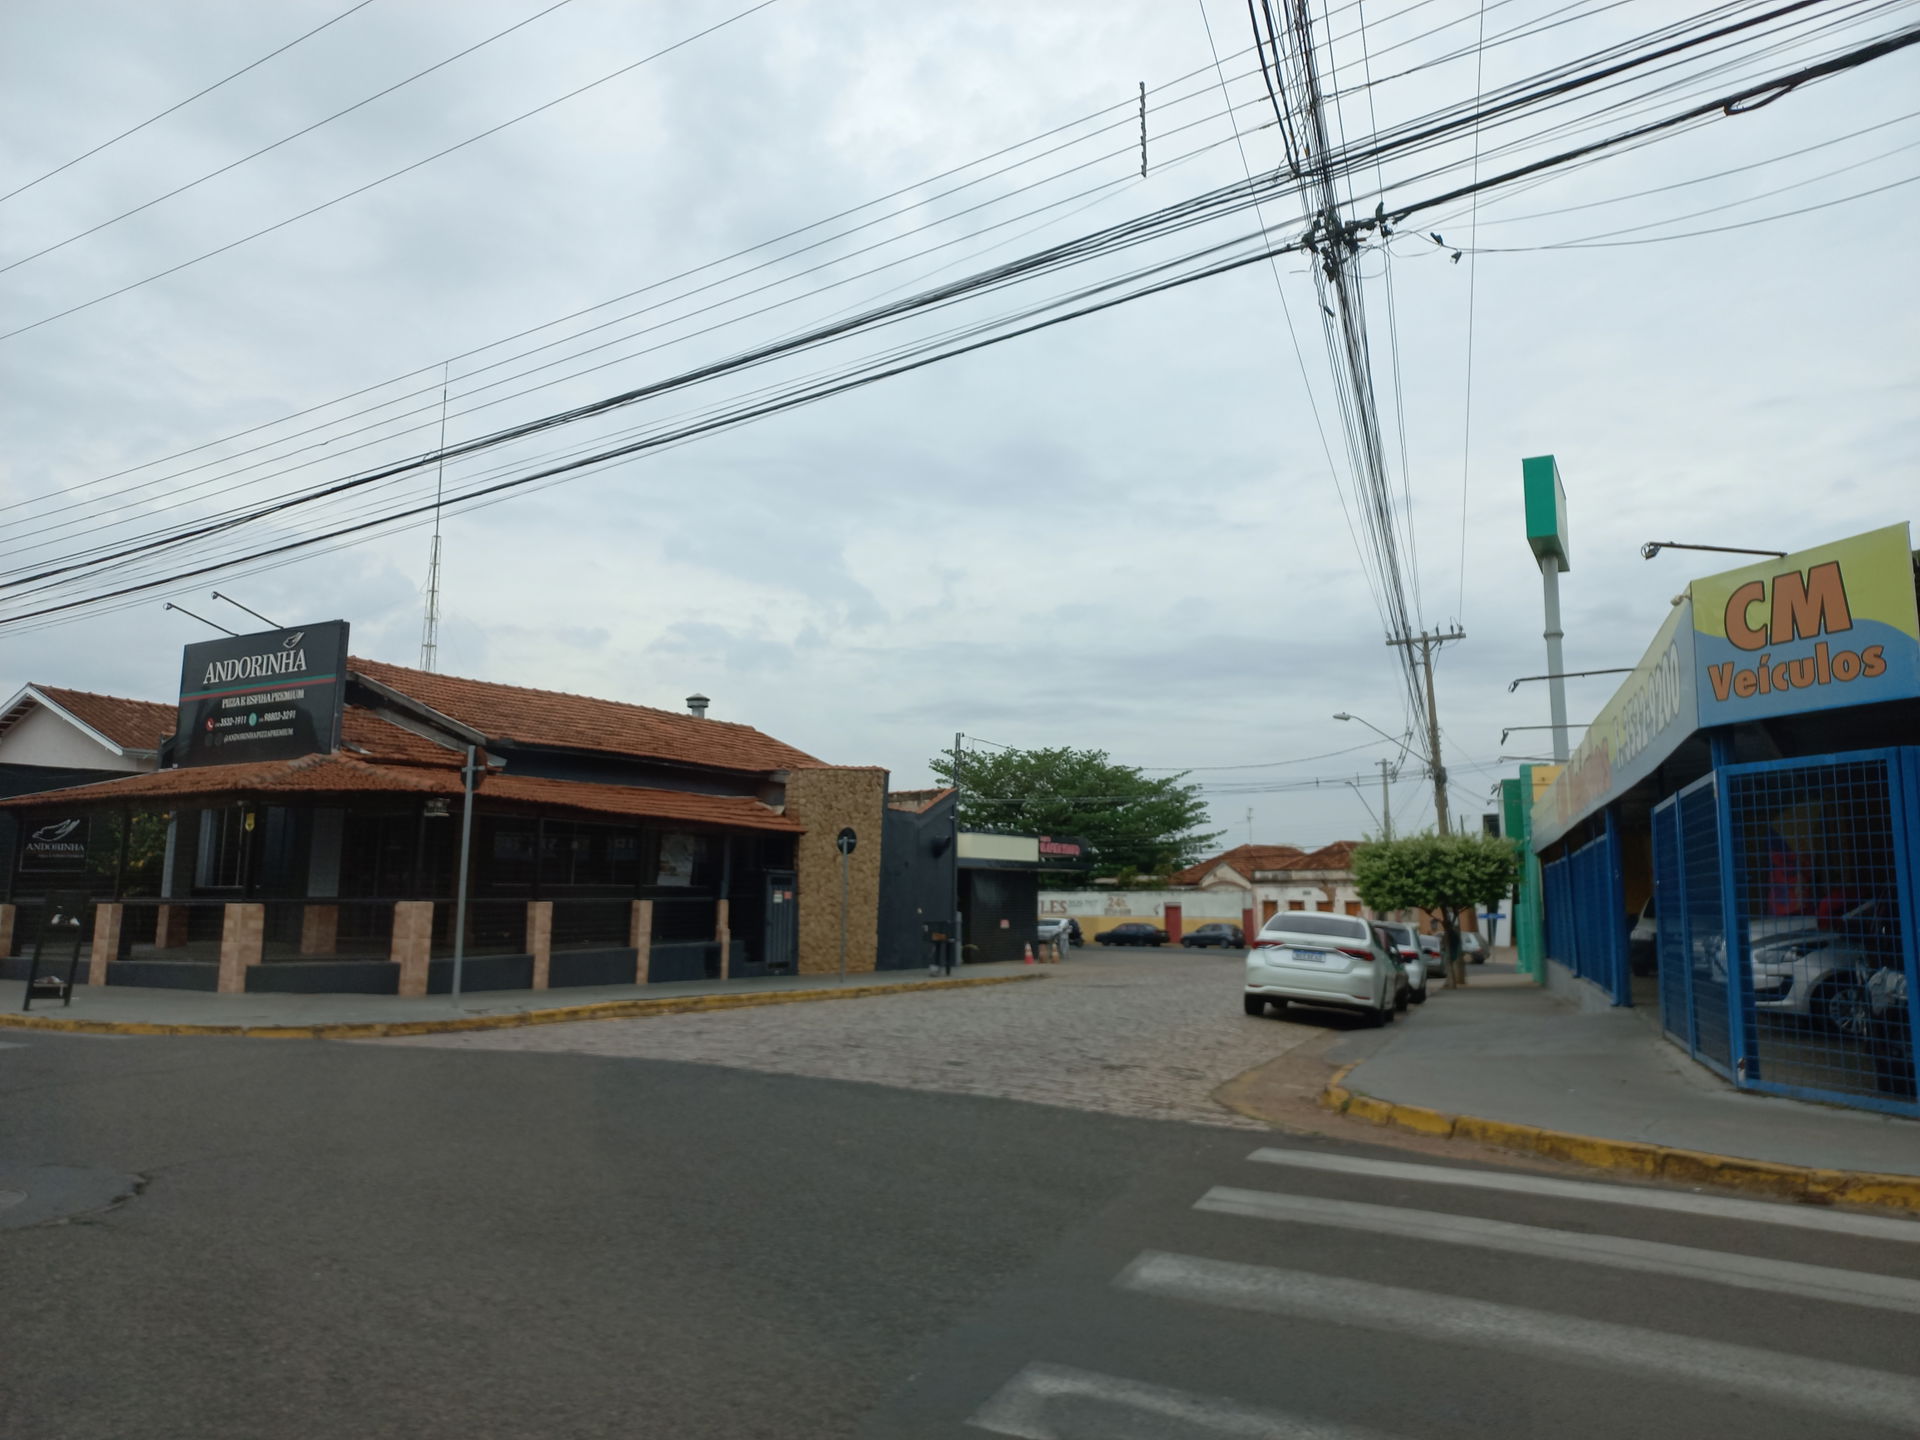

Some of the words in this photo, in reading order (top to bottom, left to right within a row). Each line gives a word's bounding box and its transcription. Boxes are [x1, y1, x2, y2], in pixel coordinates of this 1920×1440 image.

[1724, 560, 1853, 652] CM
[203, 649, 307, 684] ANDORINHA
[1707, 641, 1887, 702] Veículos
[26, 842, 84, 852] ANDORINHA
